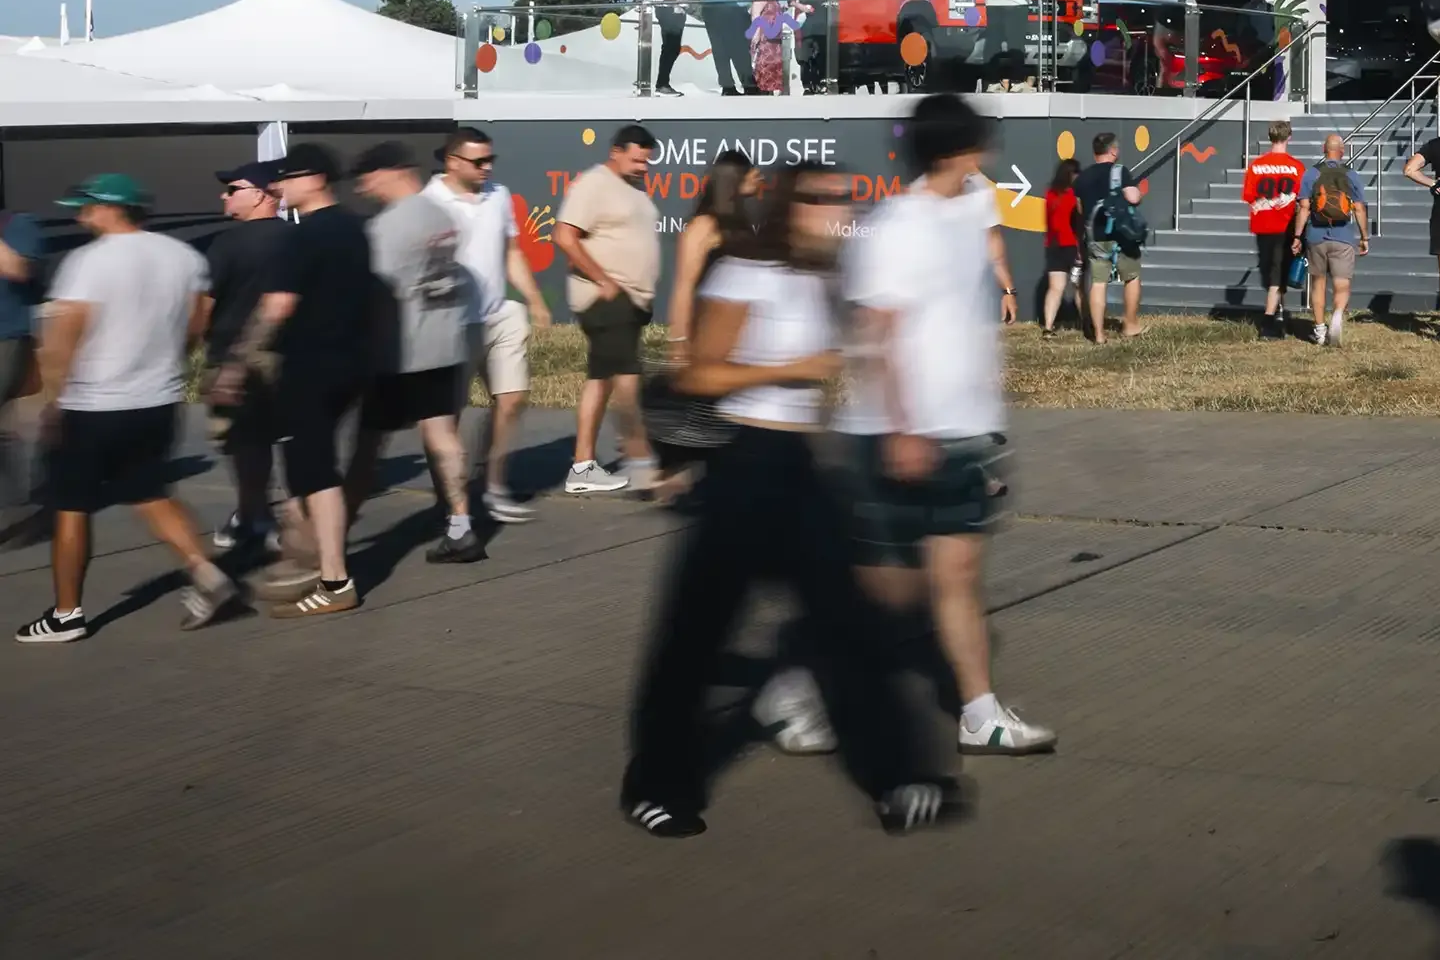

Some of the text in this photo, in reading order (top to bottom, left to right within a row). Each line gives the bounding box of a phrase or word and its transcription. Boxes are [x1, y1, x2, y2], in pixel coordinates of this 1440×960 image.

[646, 138, 836, 166] OME AND SEE
[1251, 164, 1298, 176] HONDA
